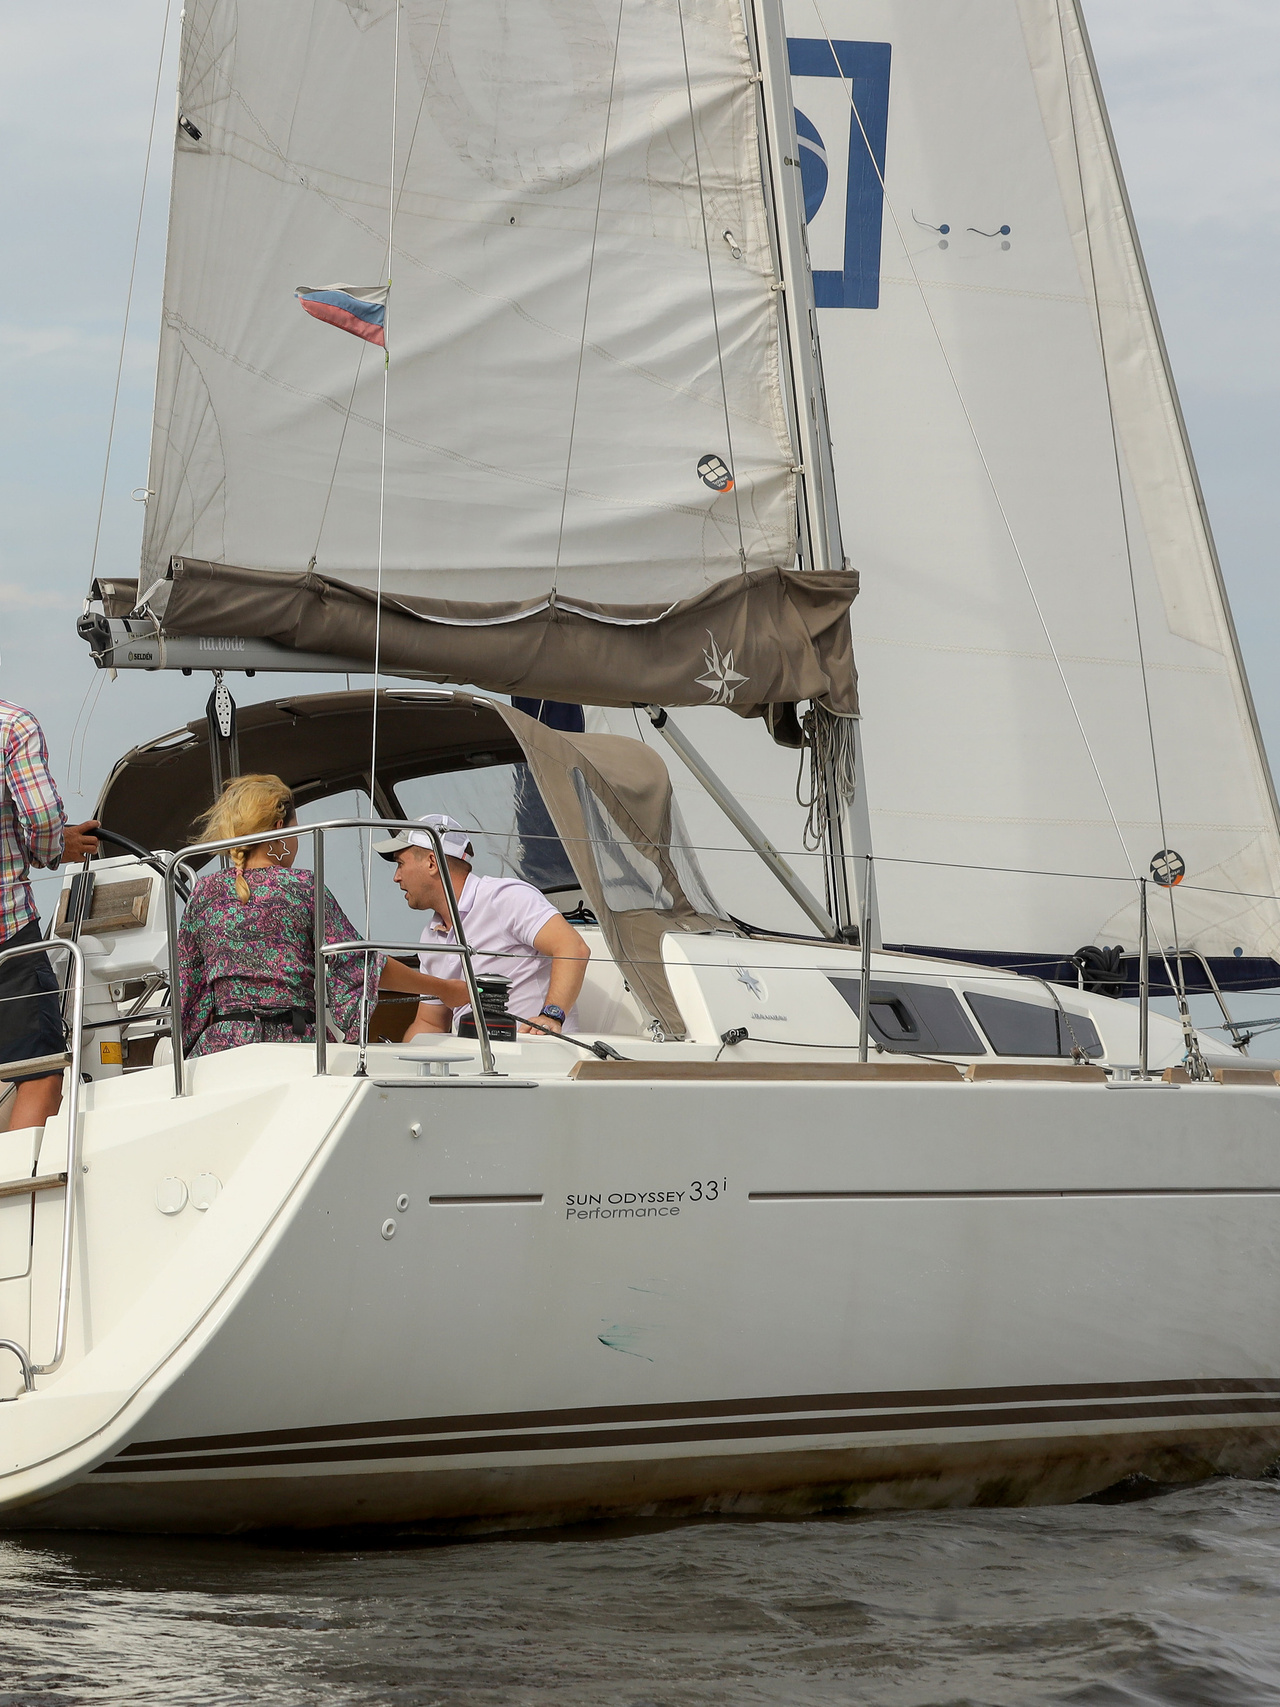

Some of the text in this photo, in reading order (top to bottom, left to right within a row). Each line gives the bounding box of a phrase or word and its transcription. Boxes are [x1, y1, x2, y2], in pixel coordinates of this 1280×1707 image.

[565, 1194, 602, 1206] SUN
[607, 1191, 686, 1204] ODYSSEY
[565, 1206, 681, 1220] Performance
